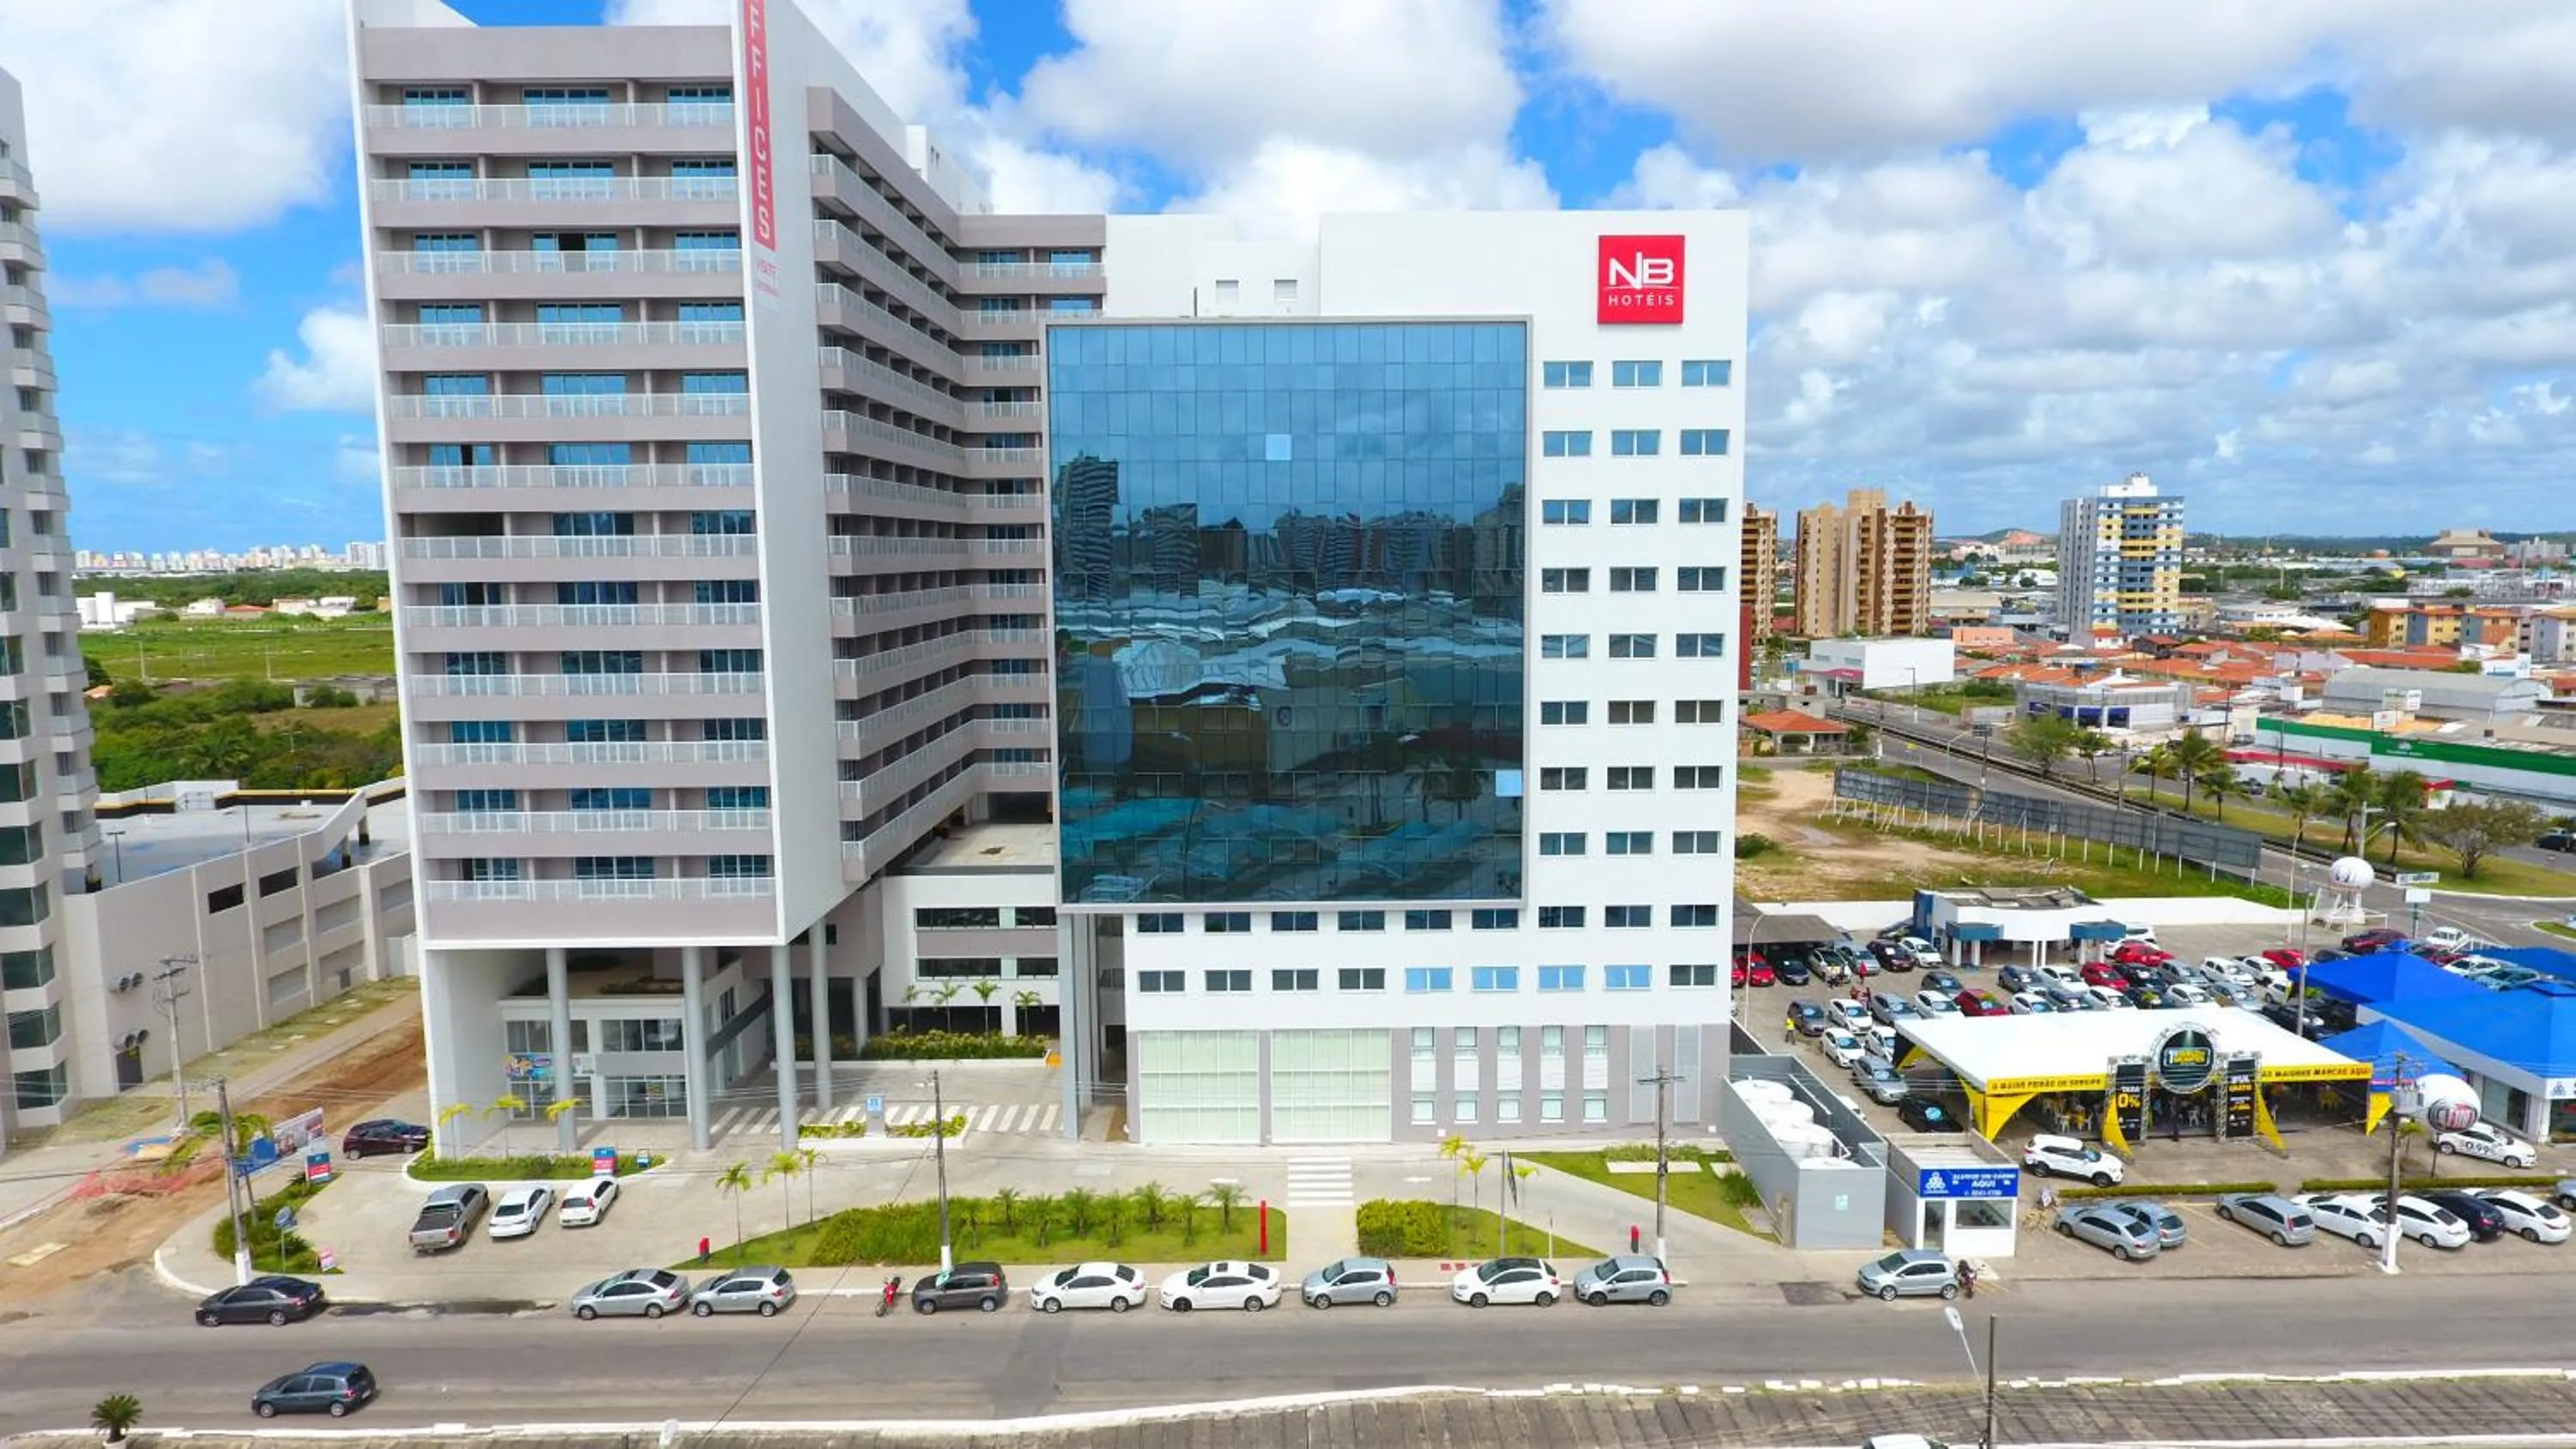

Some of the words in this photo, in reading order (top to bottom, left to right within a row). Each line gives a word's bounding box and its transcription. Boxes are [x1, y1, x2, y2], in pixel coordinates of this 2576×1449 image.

[1608, 251, 1675, 290] NB
[1607, 292, 1675, 307] HOTÉIS
[2118, 1093, 2142, 1108] 0%
